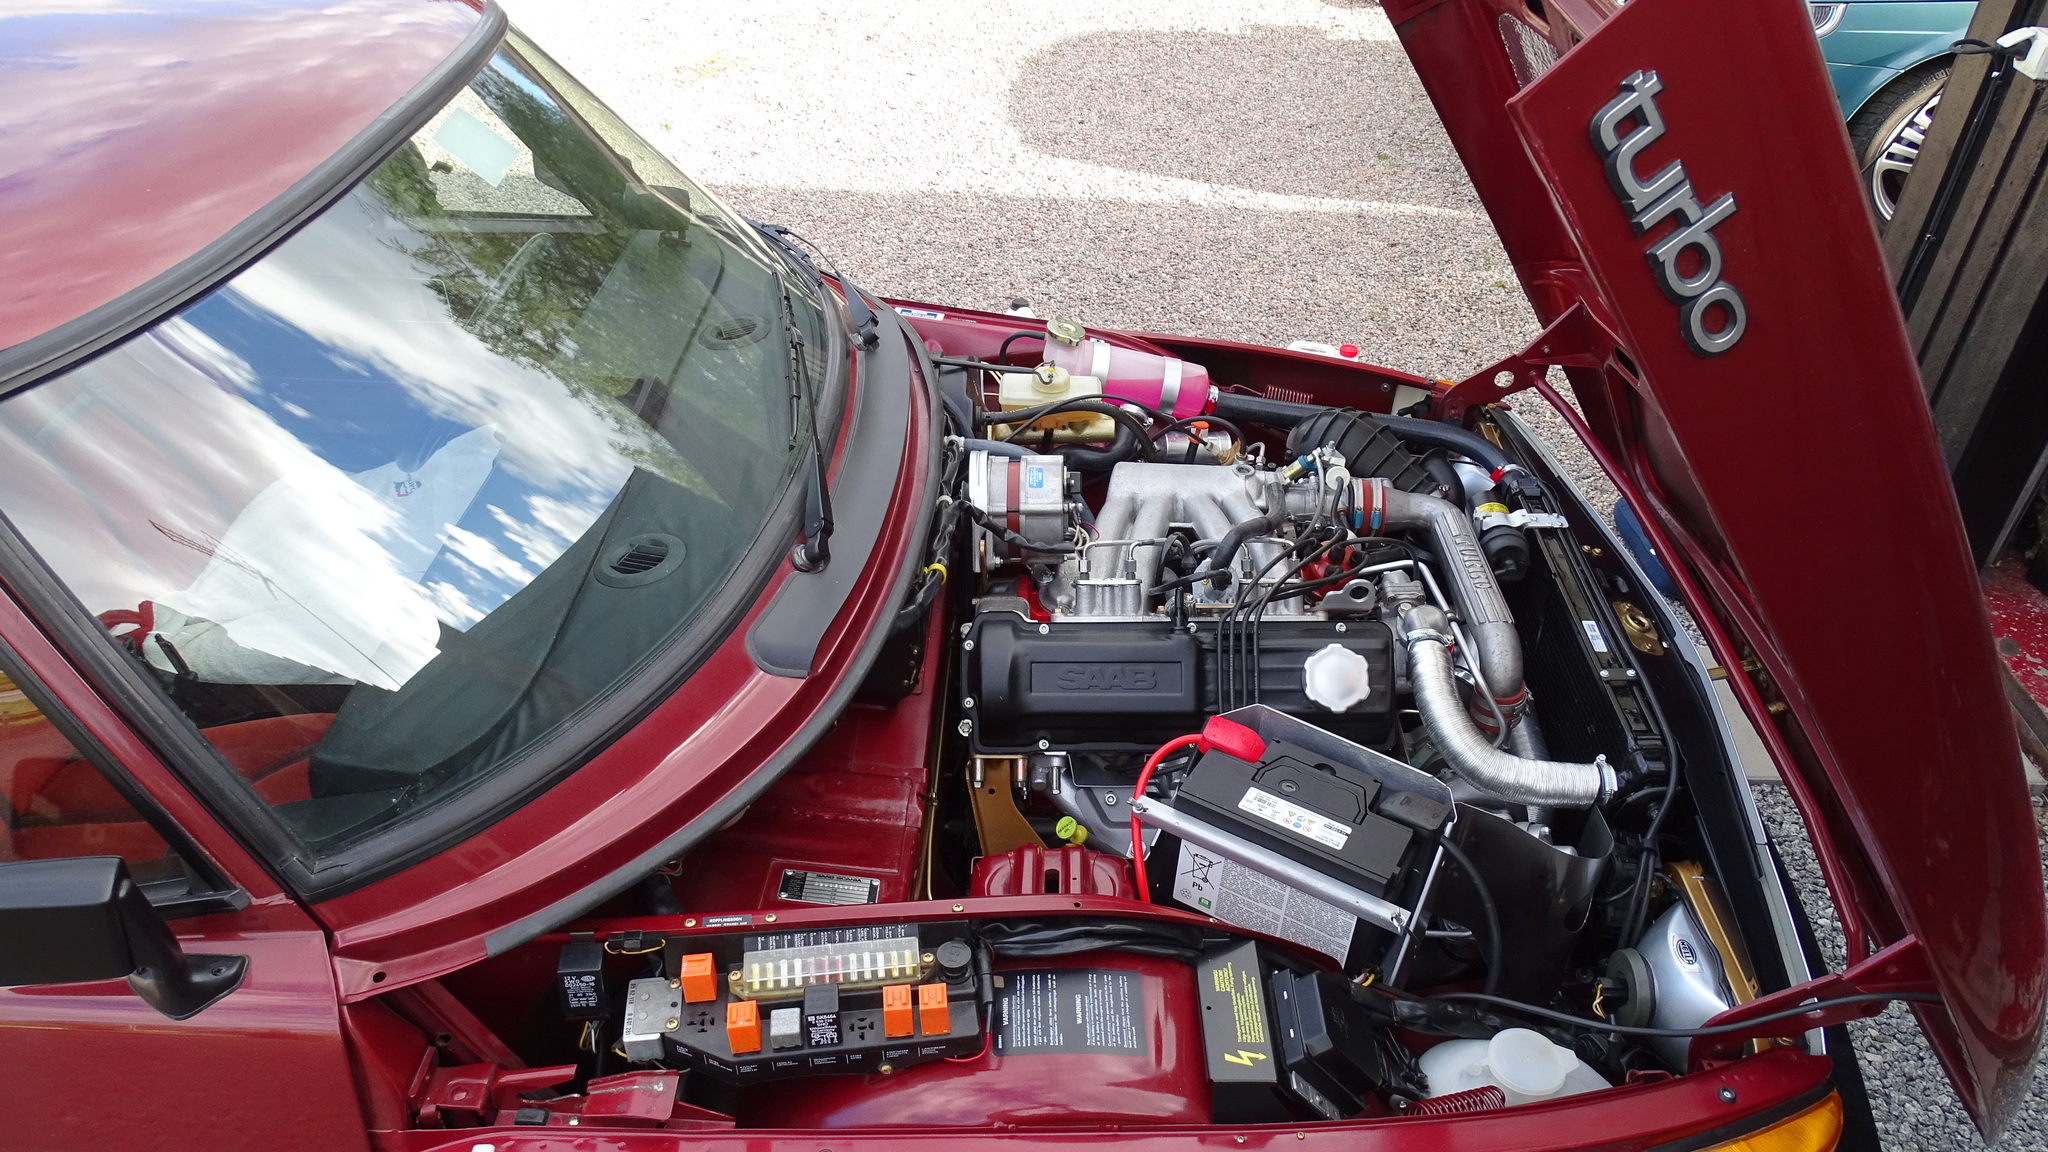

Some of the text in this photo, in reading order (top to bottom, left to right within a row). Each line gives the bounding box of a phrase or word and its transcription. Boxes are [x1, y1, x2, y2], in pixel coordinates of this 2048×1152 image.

[1590, 69, 1747, 358] turbo
[1454, 532, 1491, 590] TURBO
[1057, 665, 1157, 690] SAAB
[1192, 882, 1204, 892] Pb
[1680, 940, 1694, 966] HELLA
